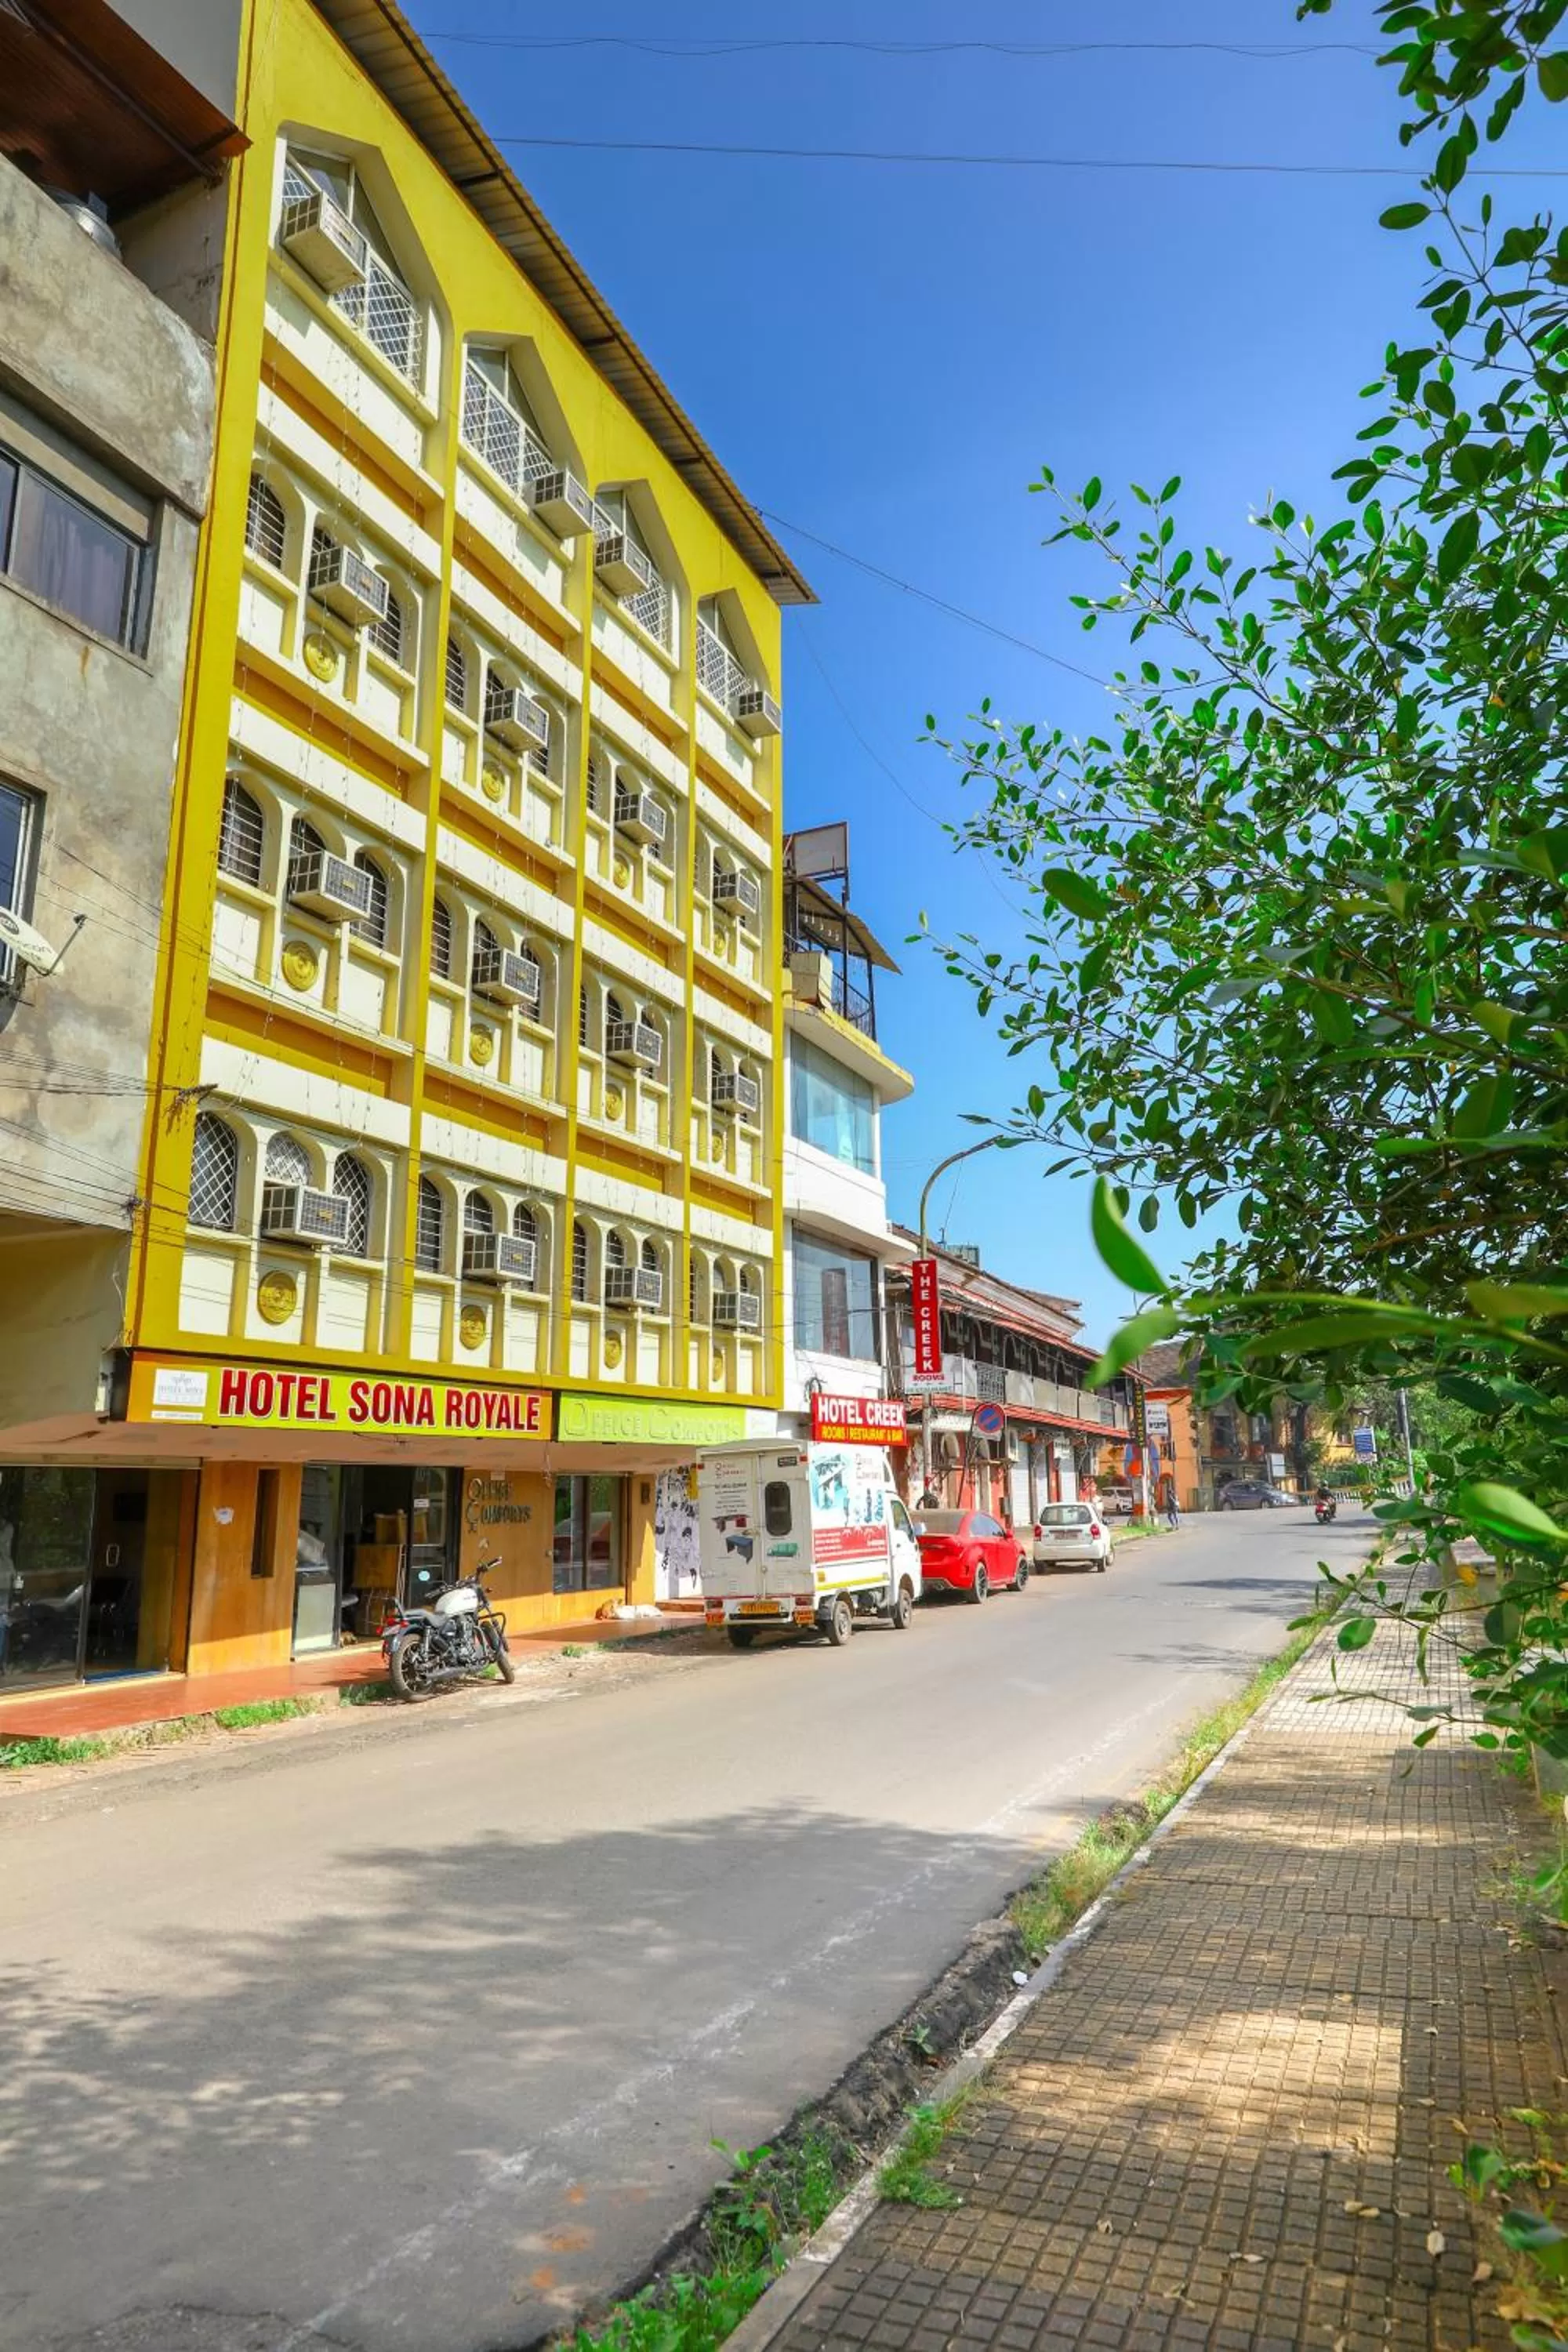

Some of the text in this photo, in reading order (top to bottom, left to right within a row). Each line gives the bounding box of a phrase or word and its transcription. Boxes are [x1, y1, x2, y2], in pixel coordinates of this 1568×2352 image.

[919, 1263, 933, 1371] THE CREEK
[219, 1368, 337, 1422] HOTEL
[348, 1379, 435, 1427] SONA
[445, 1387, 539, 1432] ROYALE
[818, 1396, 862, 1424] HOTEL
[866, 1401, 905, 1427] CREEK
[821, 1425, 846, 1440] ROOMS
